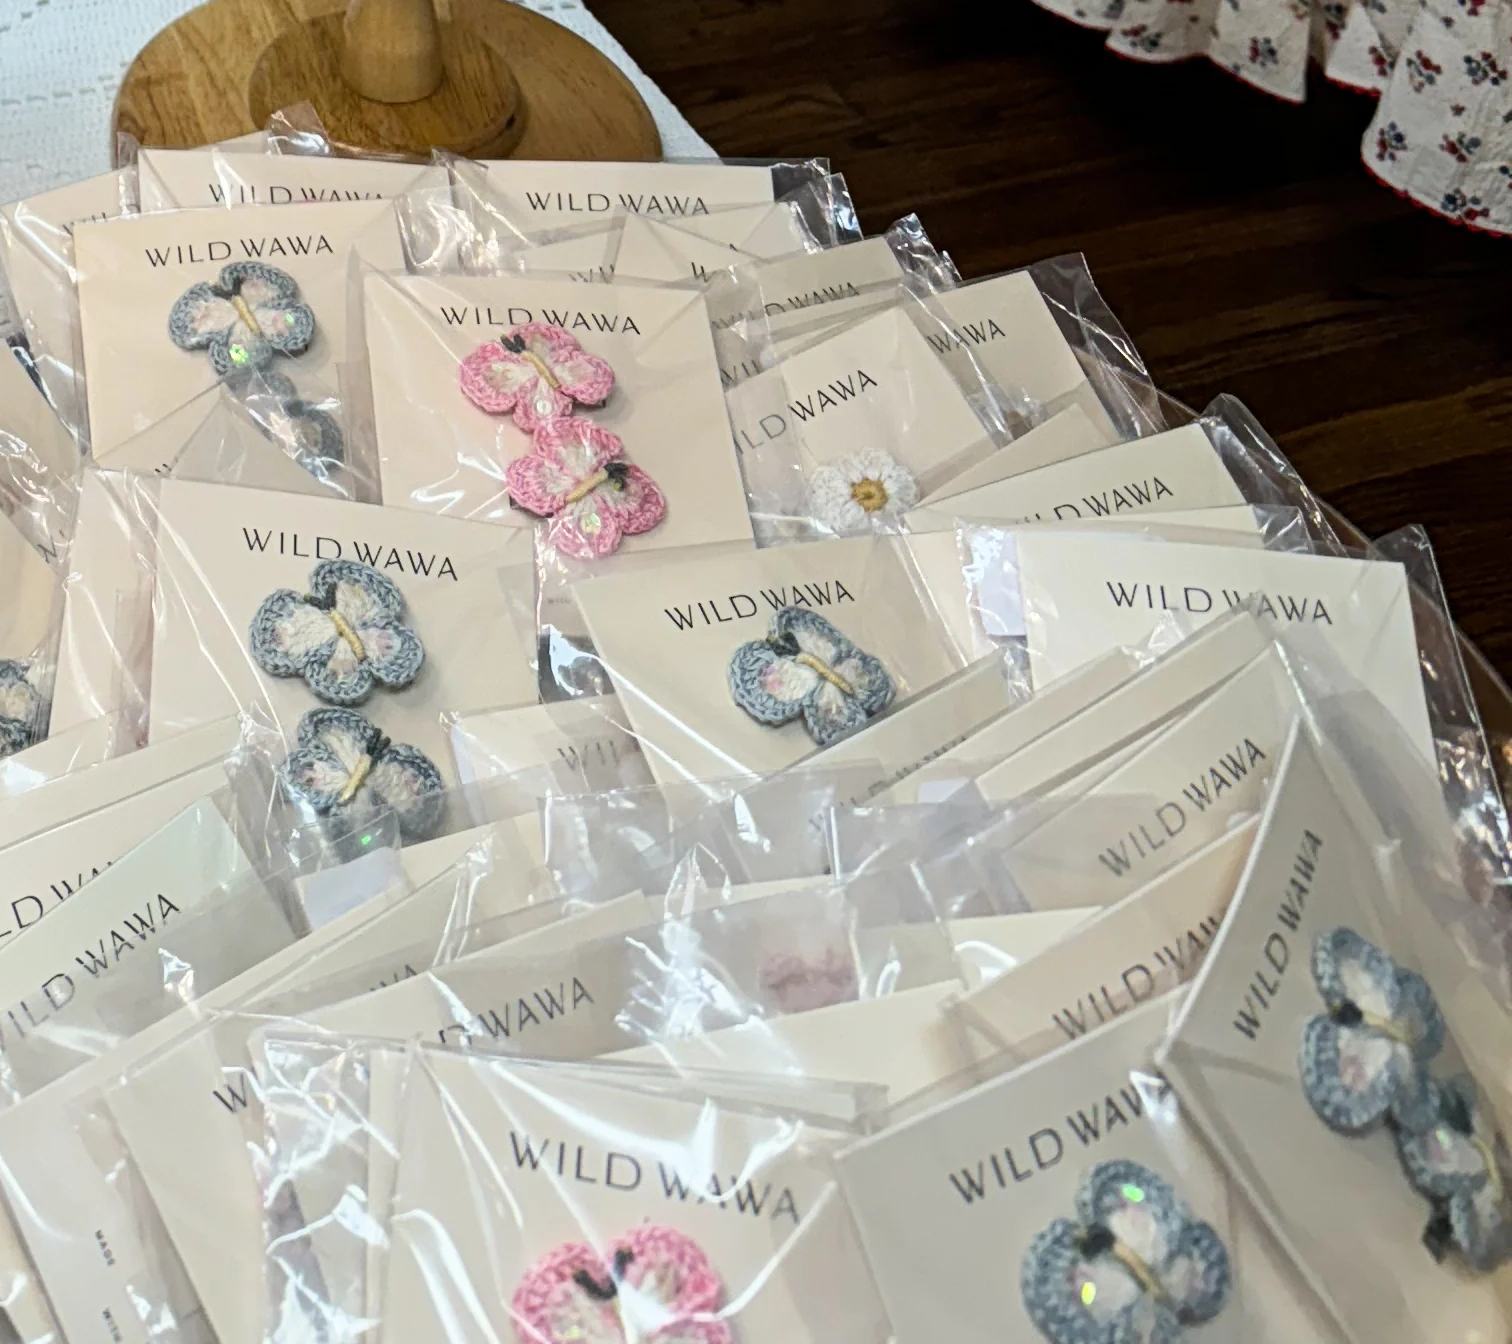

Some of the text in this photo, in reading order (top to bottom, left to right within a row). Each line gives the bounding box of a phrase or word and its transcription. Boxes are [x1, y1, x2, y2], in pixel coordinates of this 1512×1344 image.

[525, 191, 710, 215] WILD WAWA
[145, 234, 334, 268] WILD WAWA
[440, 307, 641, 336] WILD WAWA
[926, 318, 1006, 354] WAWA
[733, 369, 878, 455] ILD WAWA
[1082, 476, 1174, 517] WAWA
[242, 527, 459, 582] WILD WAWA
[664, 579, 855, 631] WILD WAWA
[1106, 581, 1333, 625] WILD WAWA
[1097, 737, 1267, 877] WILD WAWA
[75, 893, 182, 979] WAWA
[1233, 828, 1324, 1041] WILD WAWA
[477, 976, 596, 1039] WAWA
[1052, 963, 1155, 1041] WILD
[509, 1130, 801, 1225] WILD WAWA
[948, 1127, 1064, 1204] WILD
